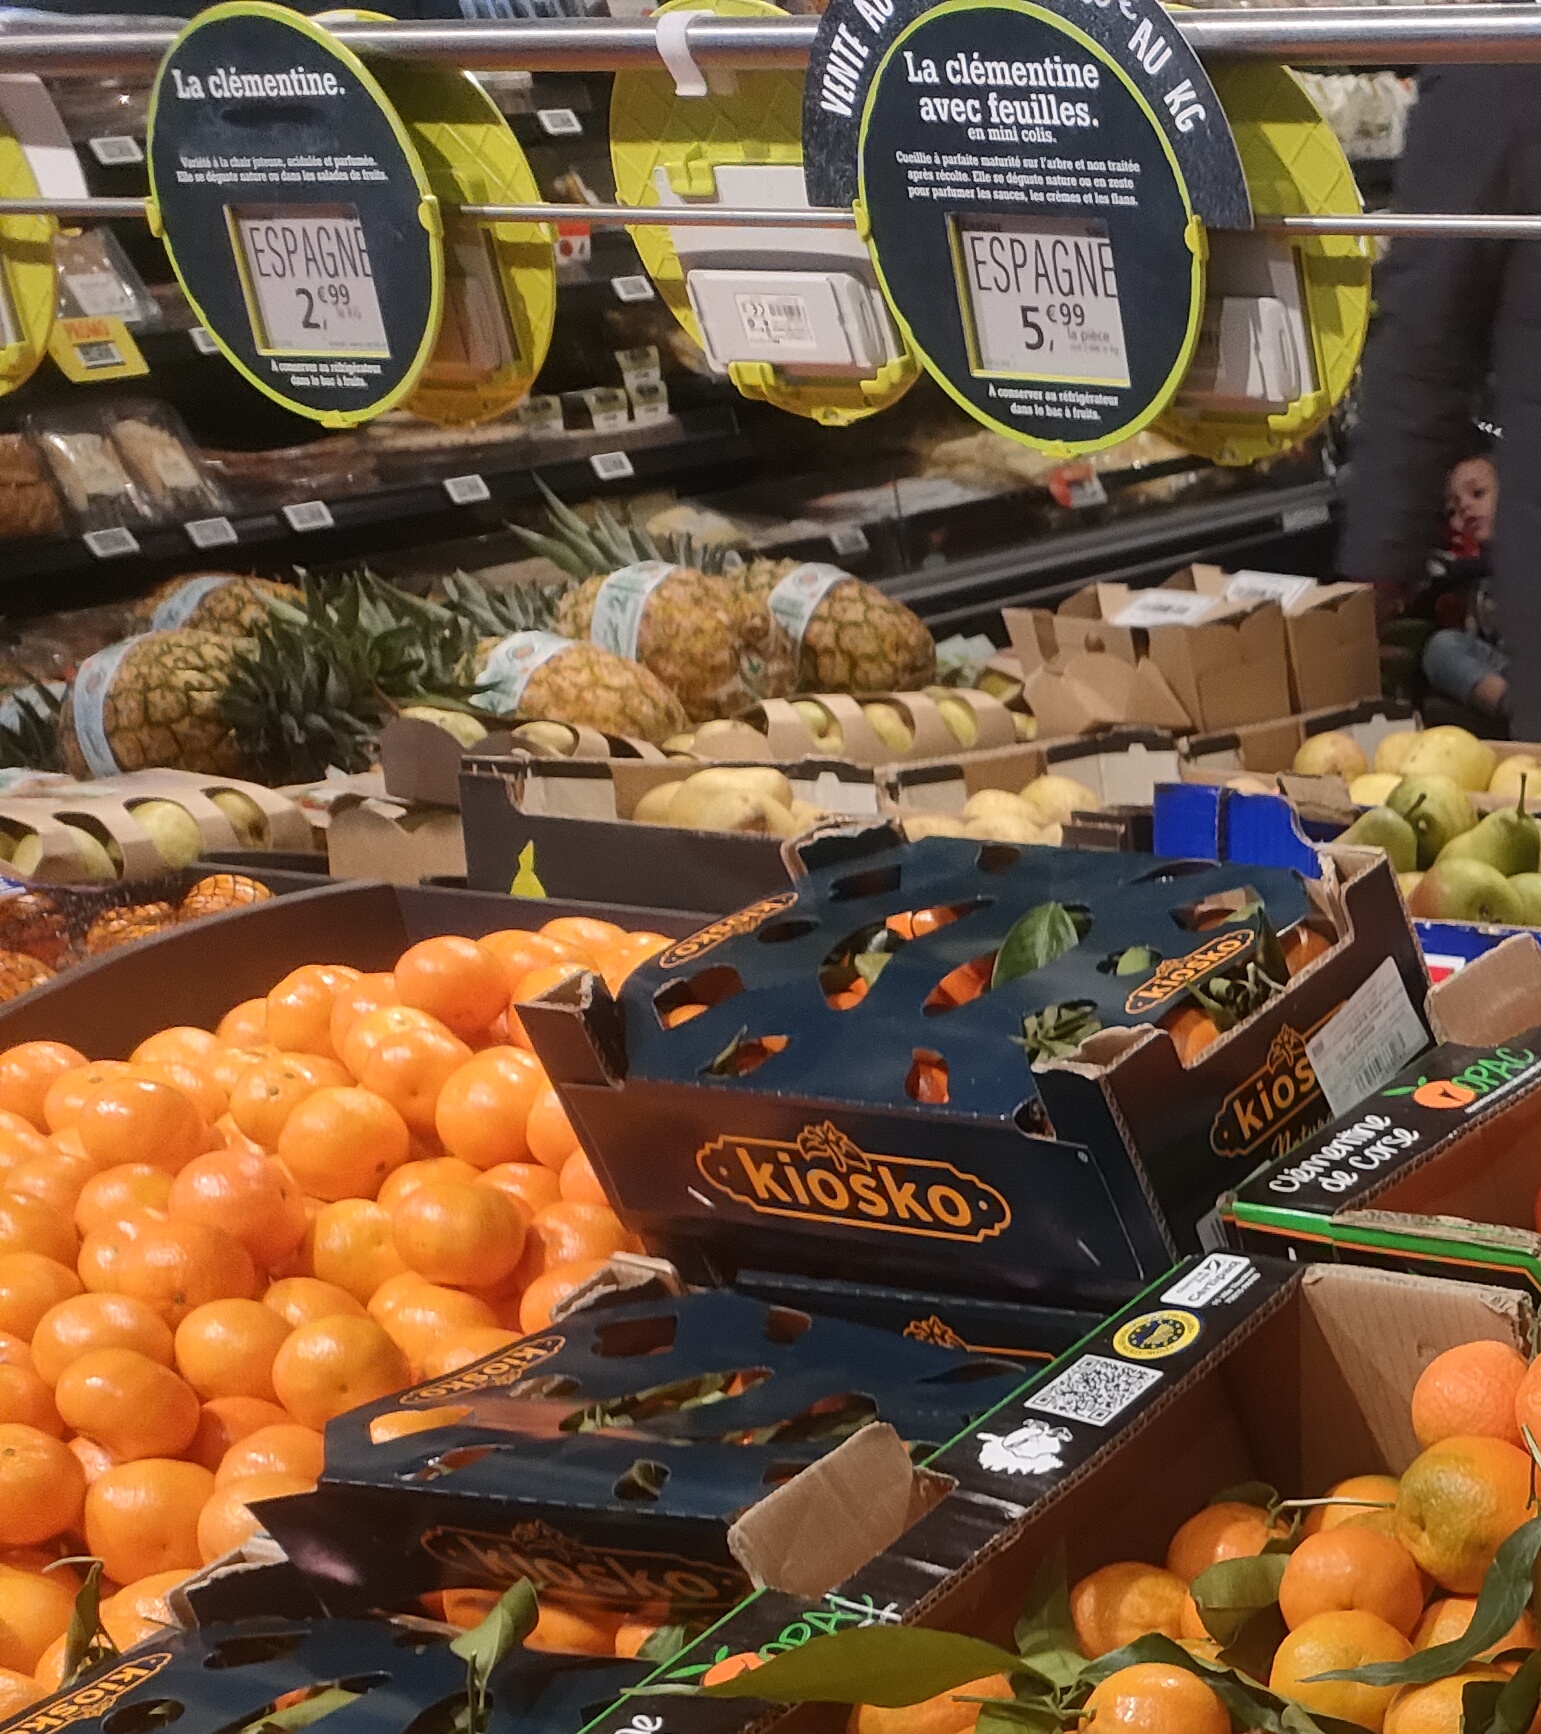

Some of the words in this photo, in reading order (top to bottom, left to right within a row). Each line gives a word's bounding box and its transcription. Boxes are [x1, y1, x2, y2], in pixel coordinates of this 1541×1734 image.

[171, 68, 205, 99] La
[208, 67, 346, 98] clémentine.
[820, 23, 868, 119] VENTE
[903, 50, 939, 84] La
[945, 52, 1100, 90] clémentine
[1127, 18, 1172, 75] AU
[1162, 79, 1208, 133] KG
[918, 96, 982, 124] avec
[987, 92, 1100, 128] feuilles.
[967, 127, 985, 141] en
[987, 126, 1019, 144] mini
[1020, 126, 1058, 144] colis.
[907, 168, 934, 182] après
[1005, 171, 1044, 187] déguste
[1045, 174, 1078, 186] nature
[942, 153, 979, 168] parfaite
[980, 155, 1021, 168] maturité
[1087, 160, 1107, 171] non
[907, 186, 931, 199] pour
[249, 225, 373, 278] ESPAGNE
[970, 236, 1119, 299] ESPAGNE
[1451, 1047, 1535, 1093] OPAC
[1232, 1056, 1315, 1140] kios
[1268, 1113, 1392, 1194] Clémentine
[1318, 1169, 1358, 1193] de
[1348, 1127, 1420, 1172] Corse
[735, 1145, 974, 1229] kiosko
